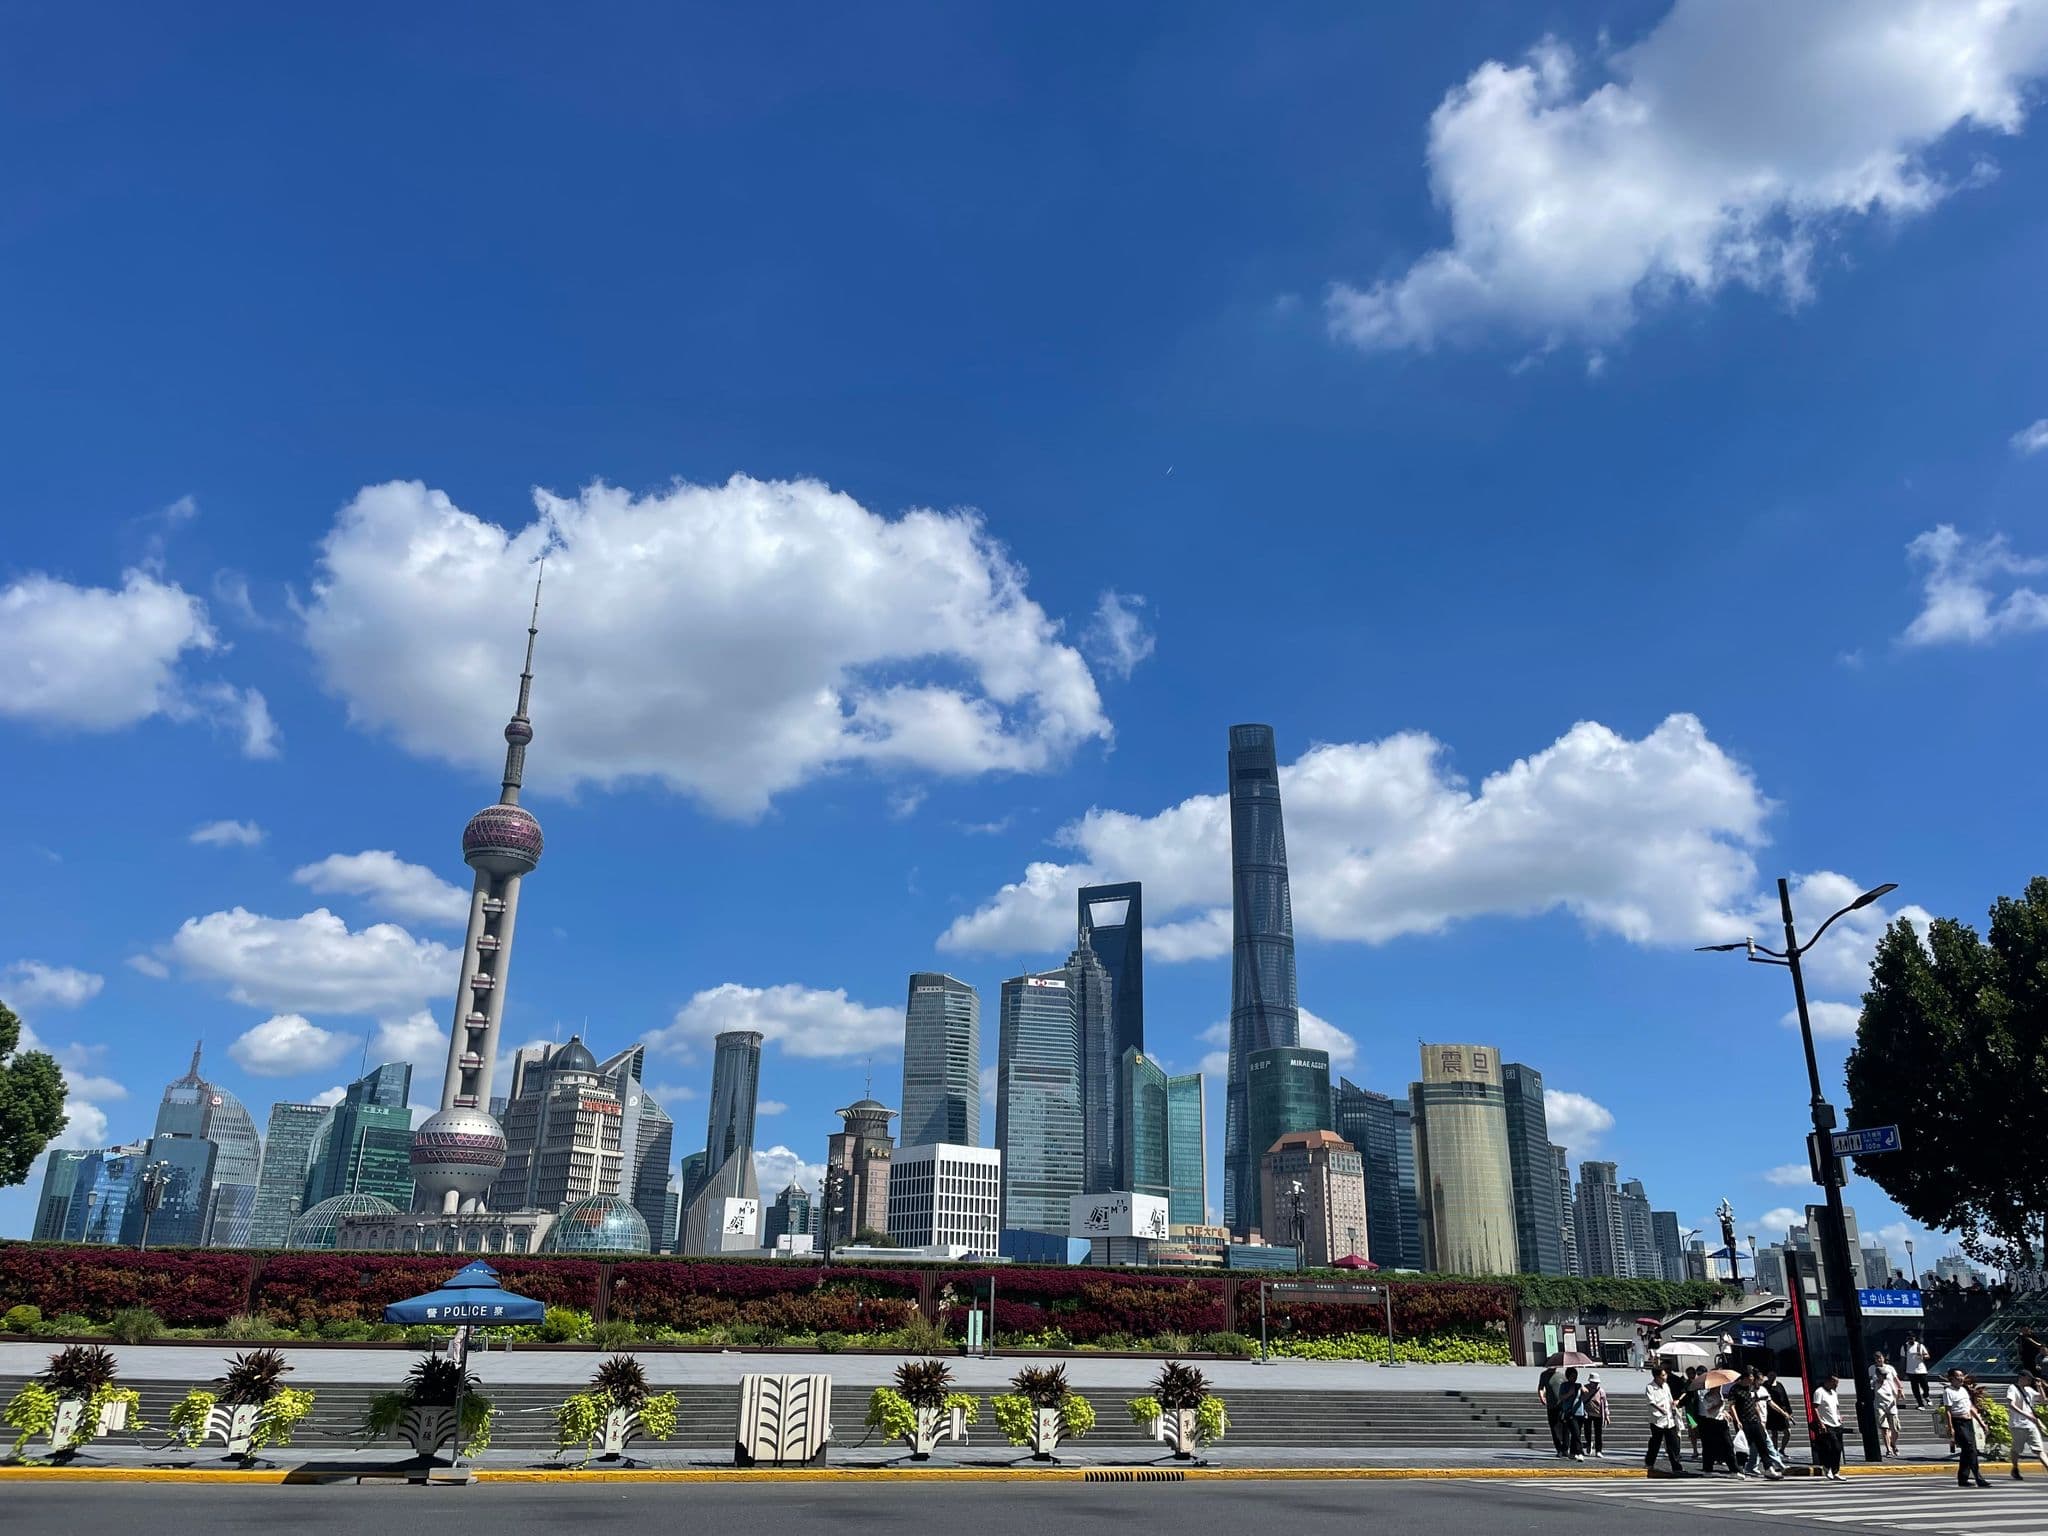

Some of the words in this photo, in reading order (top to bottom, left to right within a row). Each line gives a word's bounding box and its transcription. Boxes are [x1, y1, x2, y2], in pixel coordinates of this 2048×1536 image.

[1290, 1059, 1310, 1068] MIRAE
[1311, 1061, 1327, 1070] ASSET
[1442, 1051, 1489, 1073] 震旦
[1869, 1292, 1910, 1305] 中山东一路
[443, 1306, 488, 1318] POLICE
[494, 1306, 504, 1317] 察
[59, 1409, 73, 1436] 文明
[609, 1415, 621, 1442] 友善
